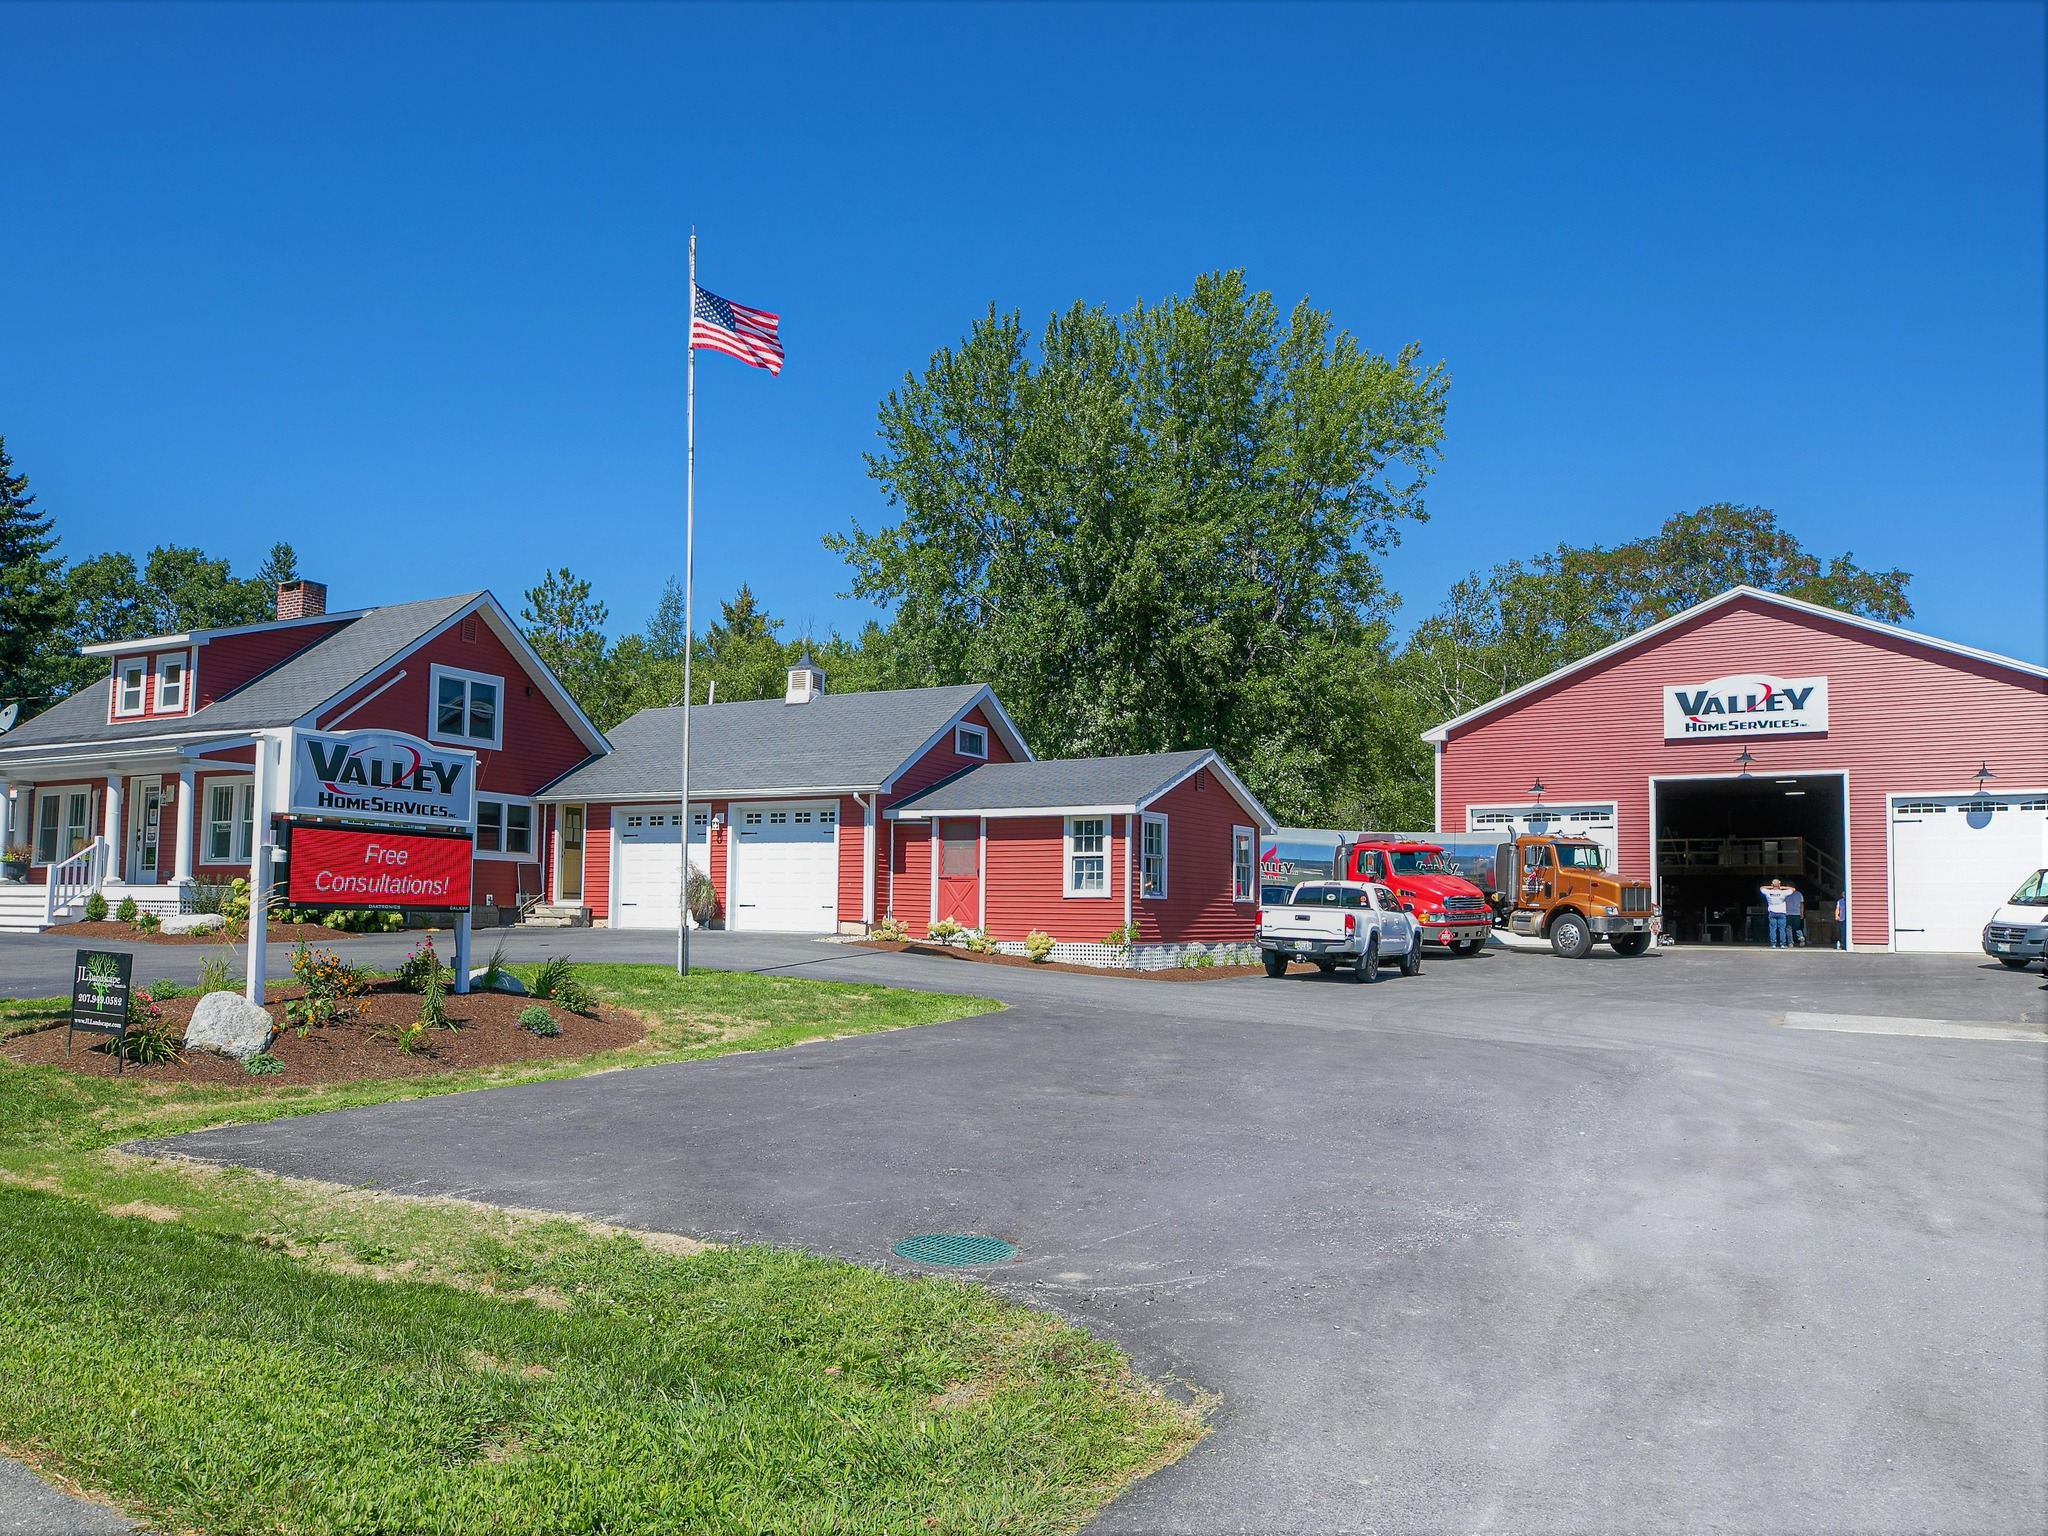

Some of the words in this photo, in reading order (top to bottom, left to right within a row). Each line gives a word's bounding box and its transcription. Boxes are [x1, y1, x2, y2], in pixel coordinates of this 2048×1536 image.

[1674, 686, 1815, 717] VALLEY
[305, 739, 464, 795] VALLEY
[364, 843, 408, 866] Free
[1261, 861, 1295, 875] ALLEY
[315, 870, 450, 896] Consultations!
[76, 966, 88, 983] JL
